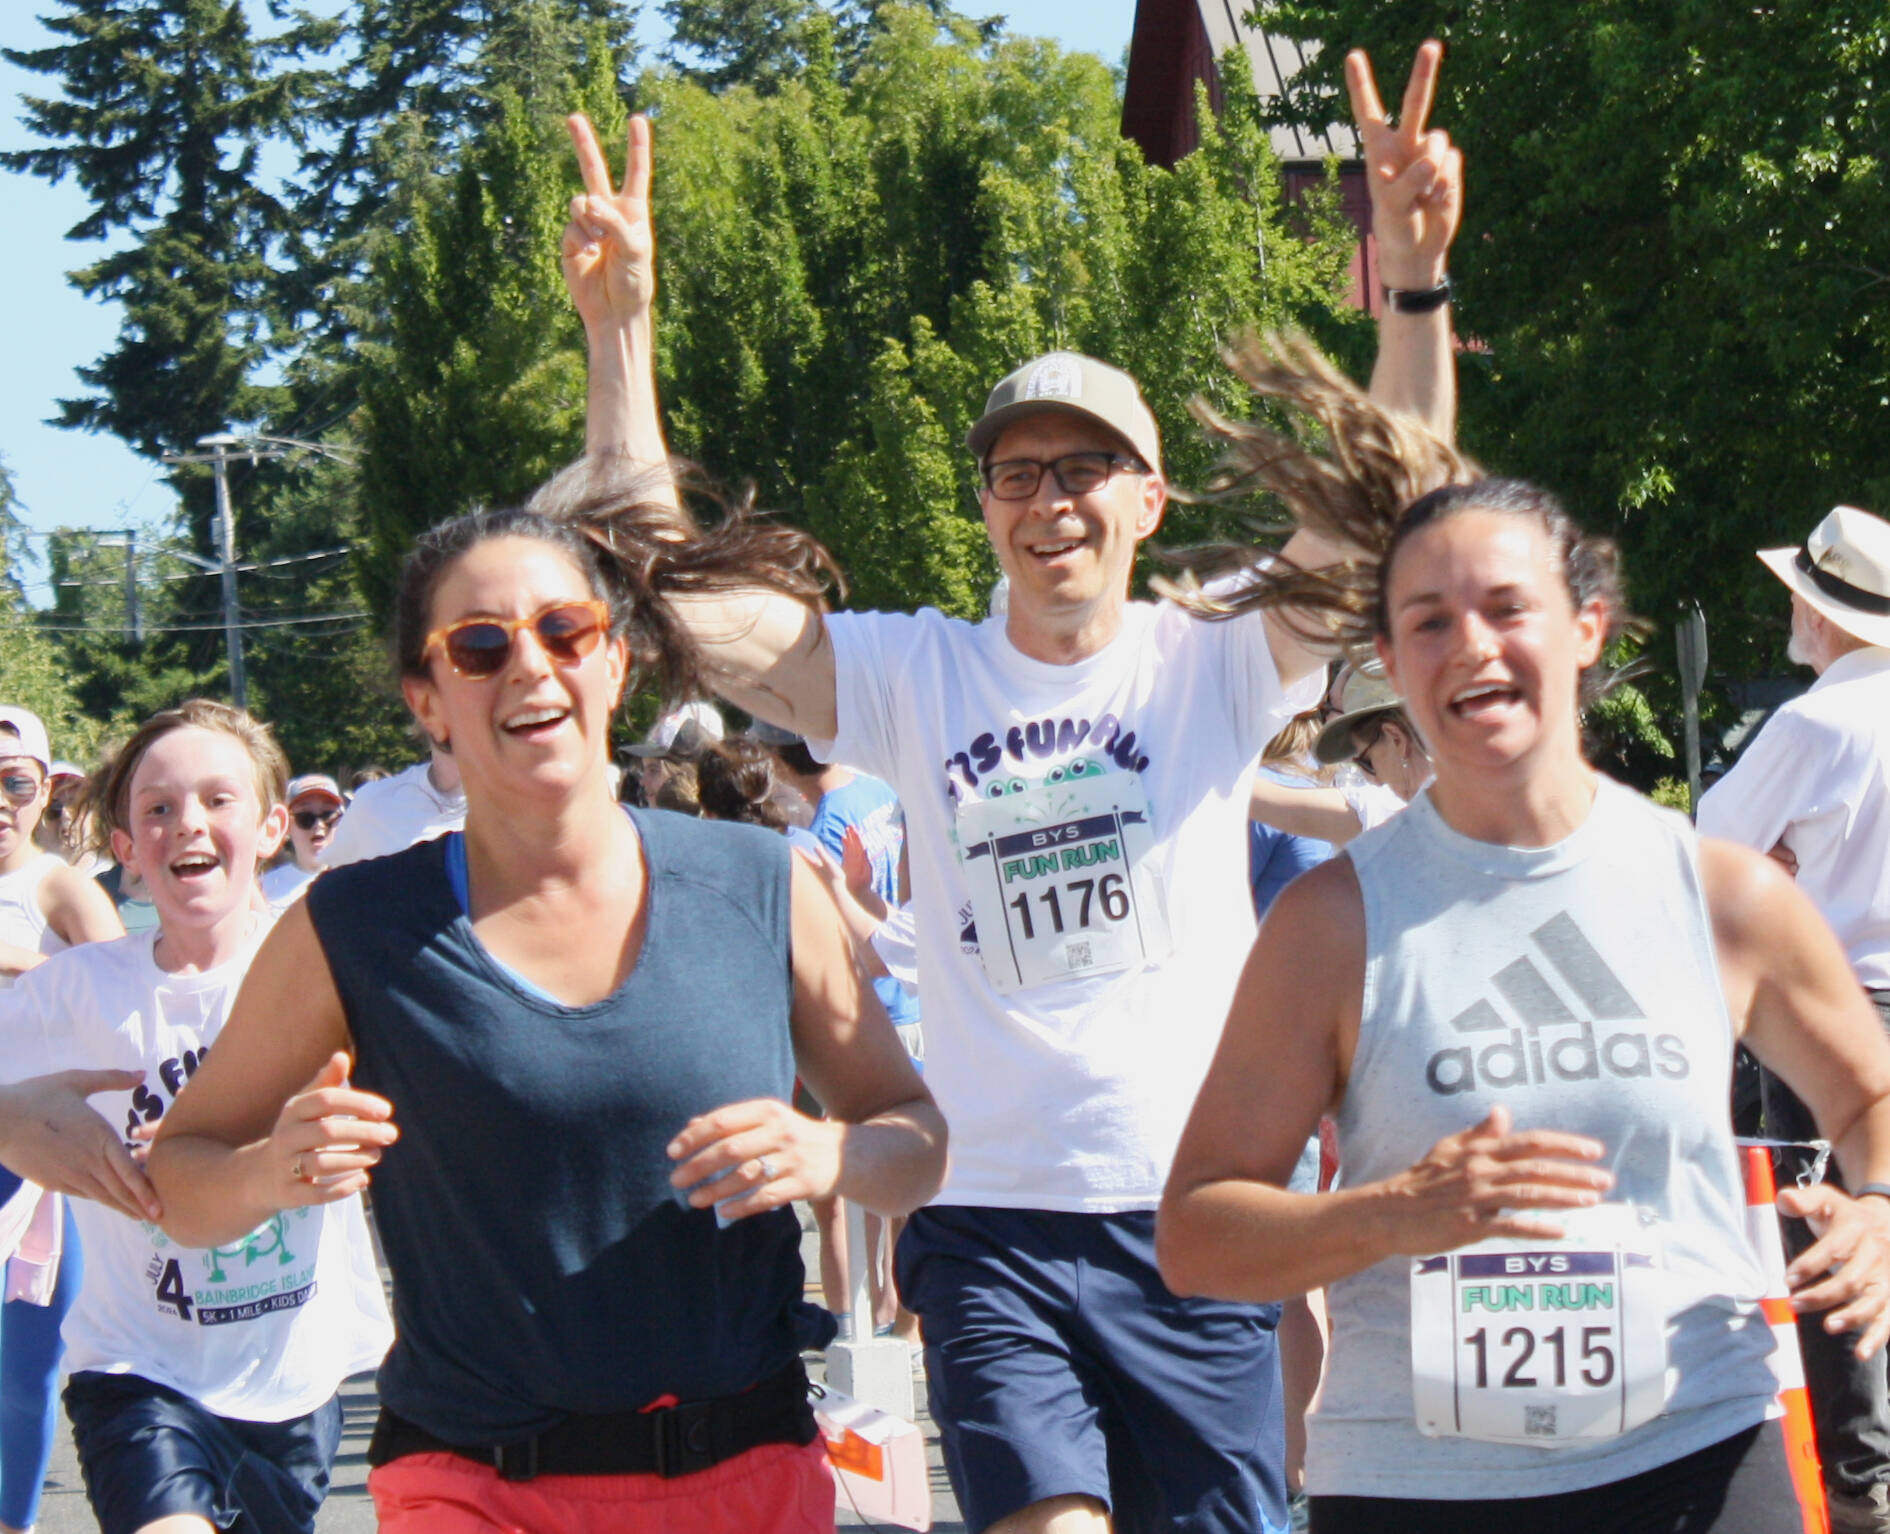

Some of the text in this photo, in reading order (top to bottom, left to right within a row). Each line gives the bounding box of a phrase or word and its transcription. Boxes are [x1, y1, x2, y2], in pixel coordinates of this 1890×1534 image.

[1006, 718, 1091, 762] FUN
[1032, 826, 1080, 847] BYS
[1002, 839, 1121, 884] FUN RUN
[1010, 873, 1130, 940] 1176
[1426, 1021, 1690, 1096] adidas
[1505, 1256, 1570, 1273] BYS
[157, 1258, 194, 1321] 4
[194, 1280, 278, 1306] BAINBRIDGE
[203, 1311, 218, 1324] 5K
[237, 1303, 262, 1320] MILE
[271, 1290, 296, 1311] KIDS
[1462, 1283, 1614, 1312] FUN RUN
[1464, 1326, 1615, 1388] 1215
